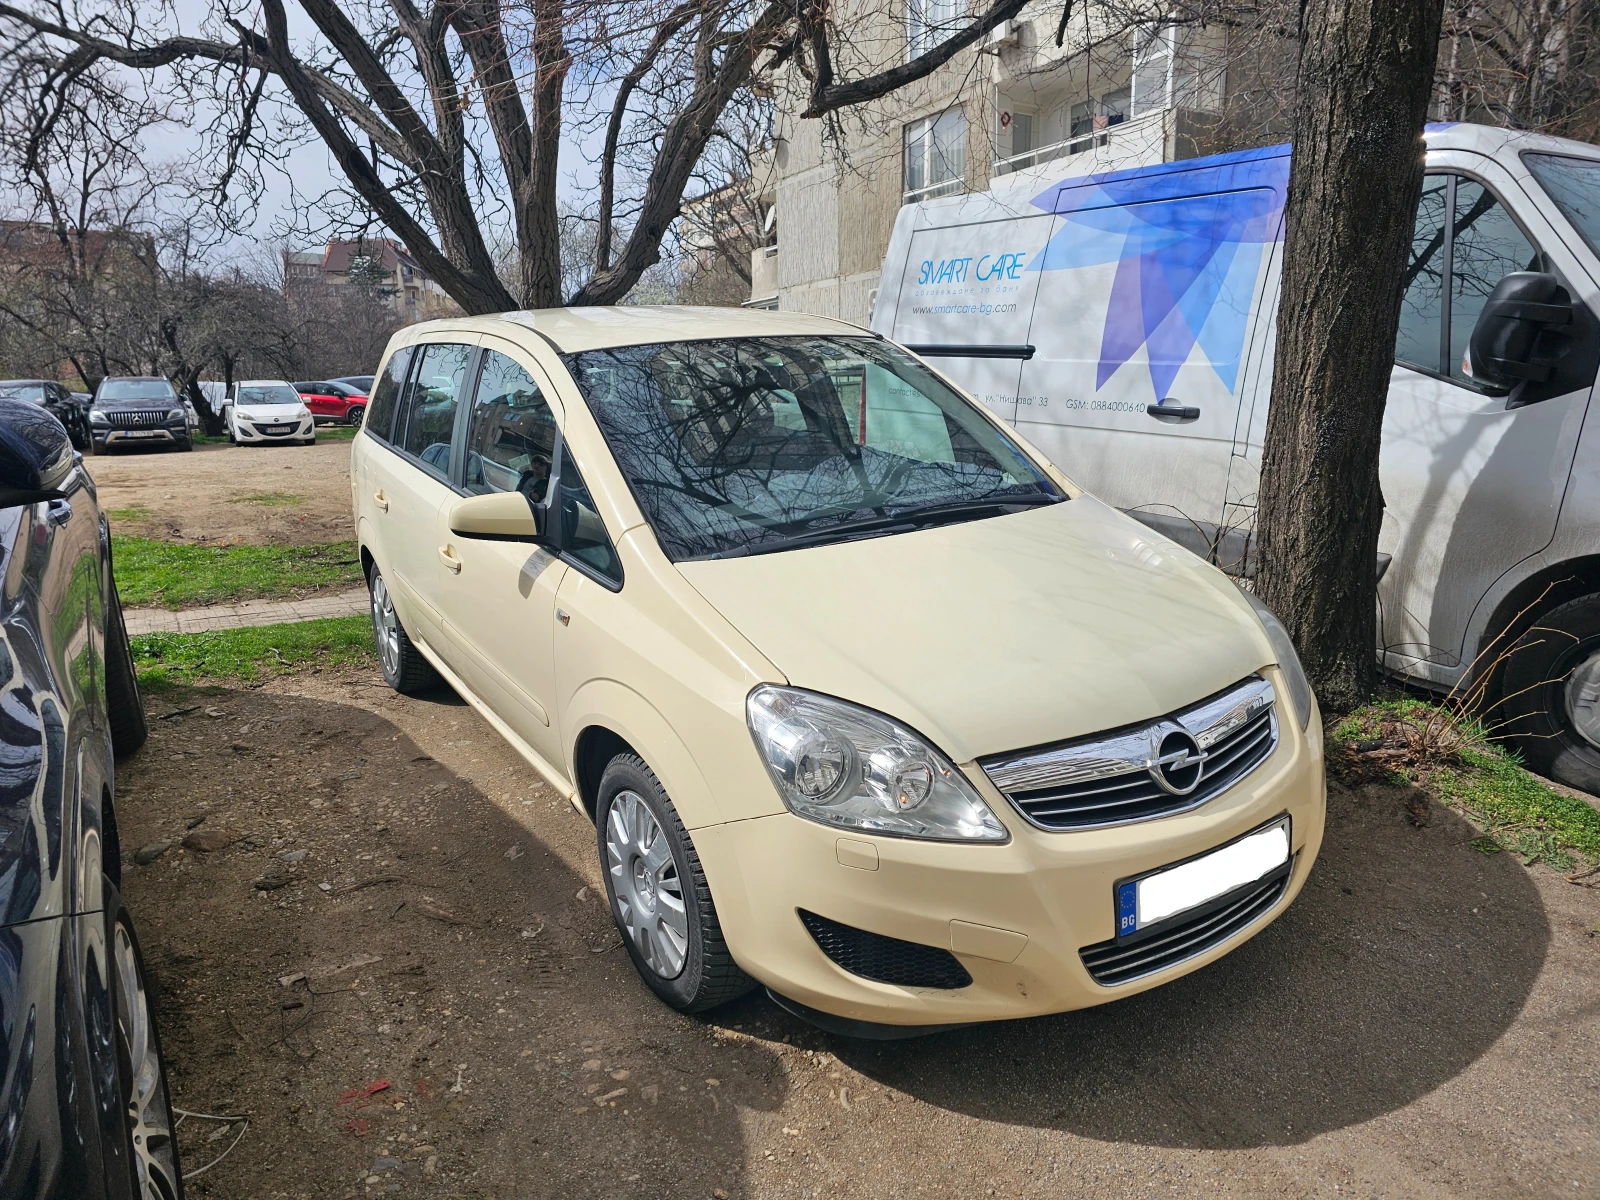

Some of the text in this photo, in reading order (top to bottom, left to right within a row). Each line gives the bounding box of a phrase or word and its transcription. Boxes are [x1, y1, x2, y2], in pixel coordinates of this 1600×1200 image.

[918, 252, 1026, 284] SMART CARE
[996, 285, 1019, 293] баня
[912, 303, 1017, 316] www.smartcare-bg.com
[1038, 396, 1049, 407] 33
[1066, 399, 1146, 413] GSM: 0884000640
[1121, 914, 1135, 929] BG
